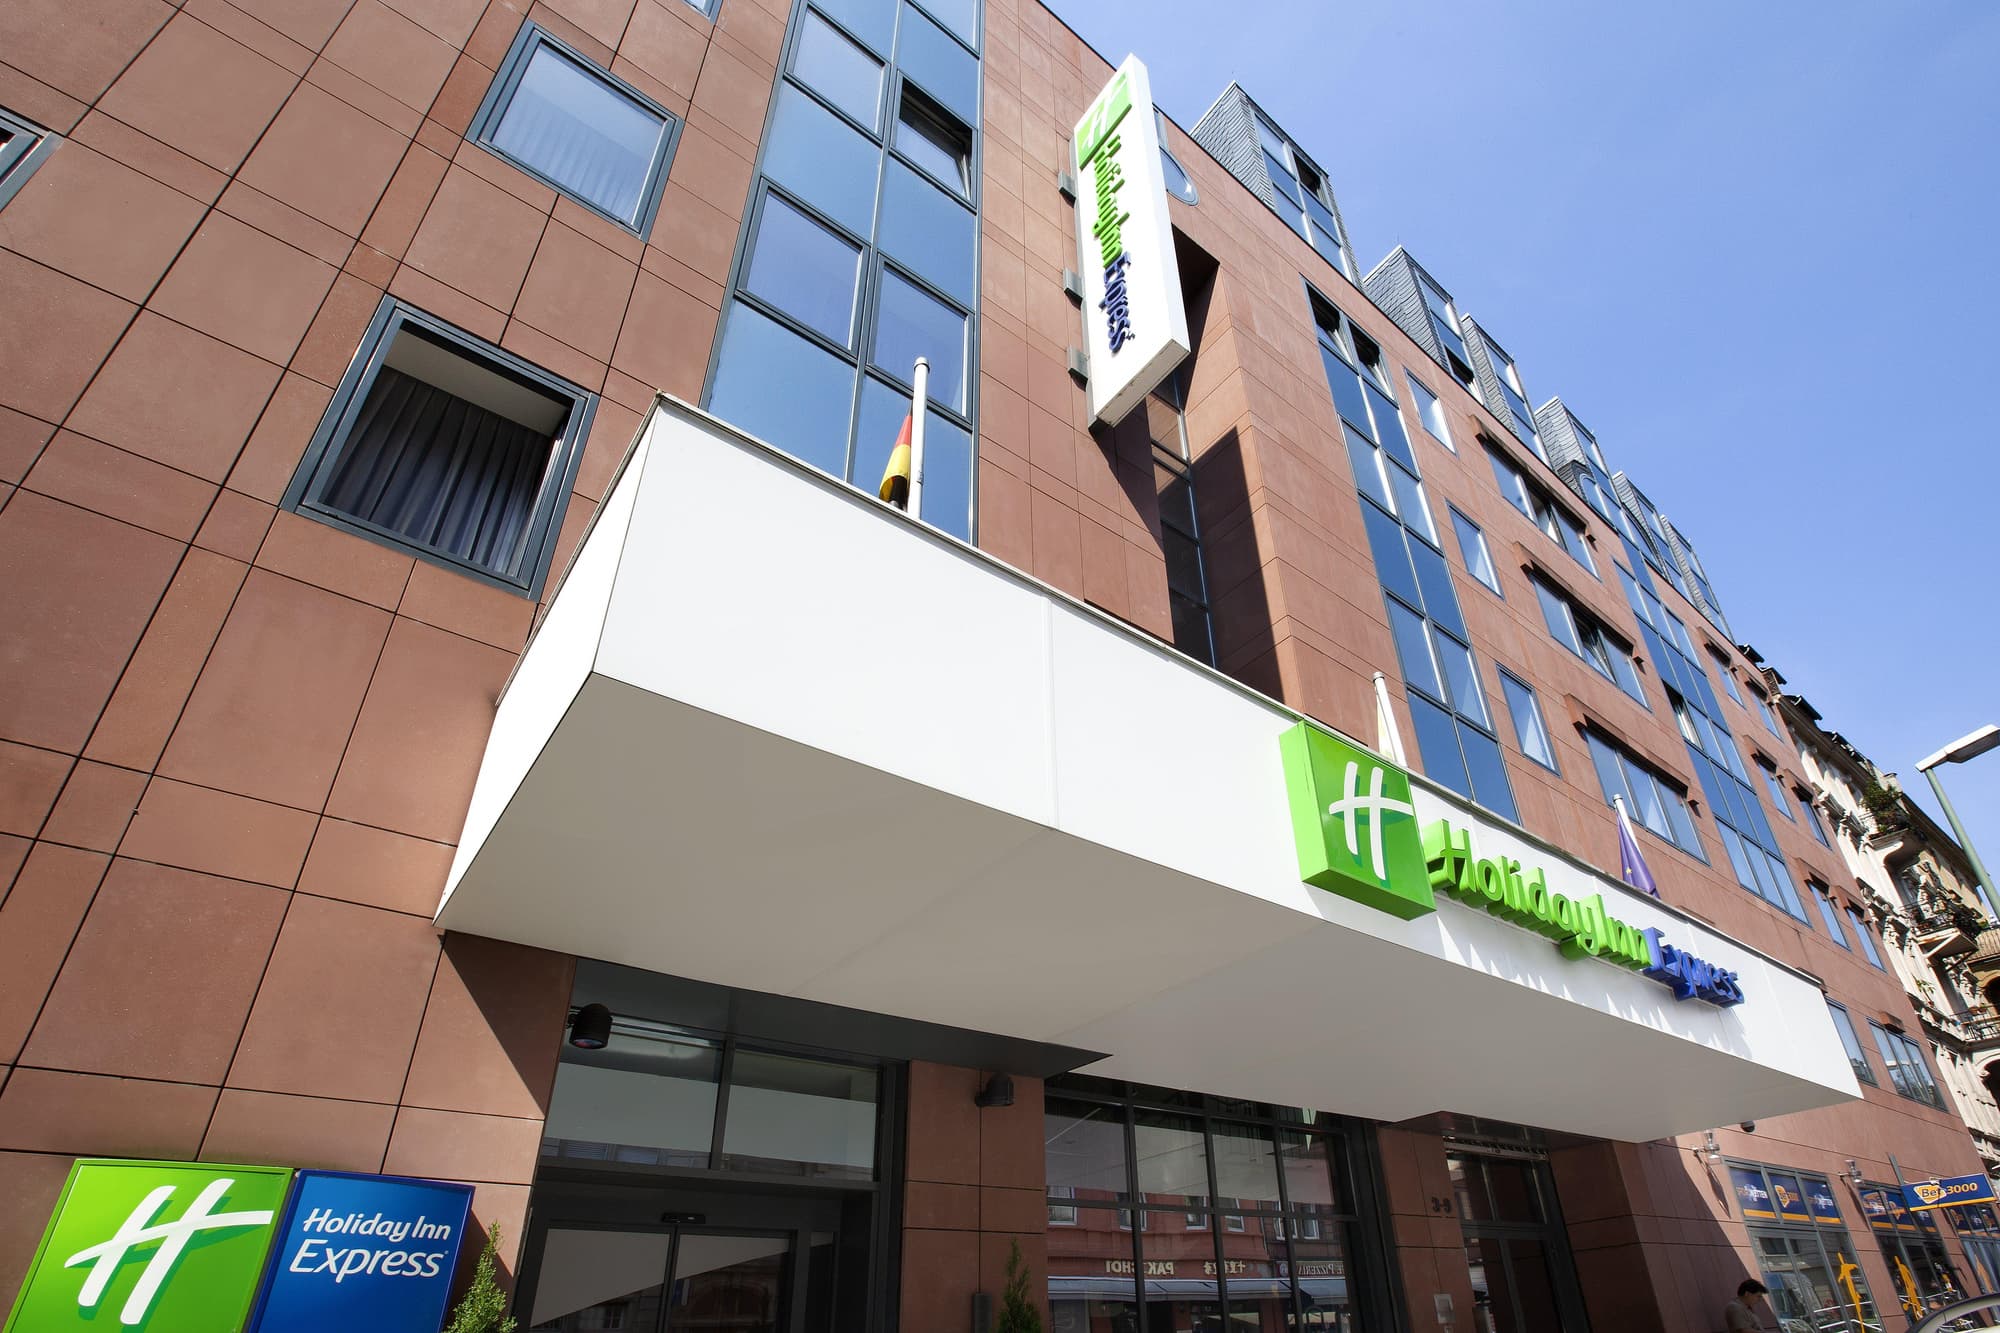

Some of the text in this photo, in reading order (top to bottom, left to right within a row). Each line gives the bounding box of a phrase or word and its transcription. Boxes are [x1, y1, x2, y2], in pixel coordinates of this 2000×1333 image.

[1092, 134, 1125, 236] Holiday
[1098, 251, 1134, 353] Express
[1426, 818, 1745, 1008] Holiday Inn Express
[289, 1238, 444, 1283] Express
[303, 1208, 451, 1242] Holiday Inn
